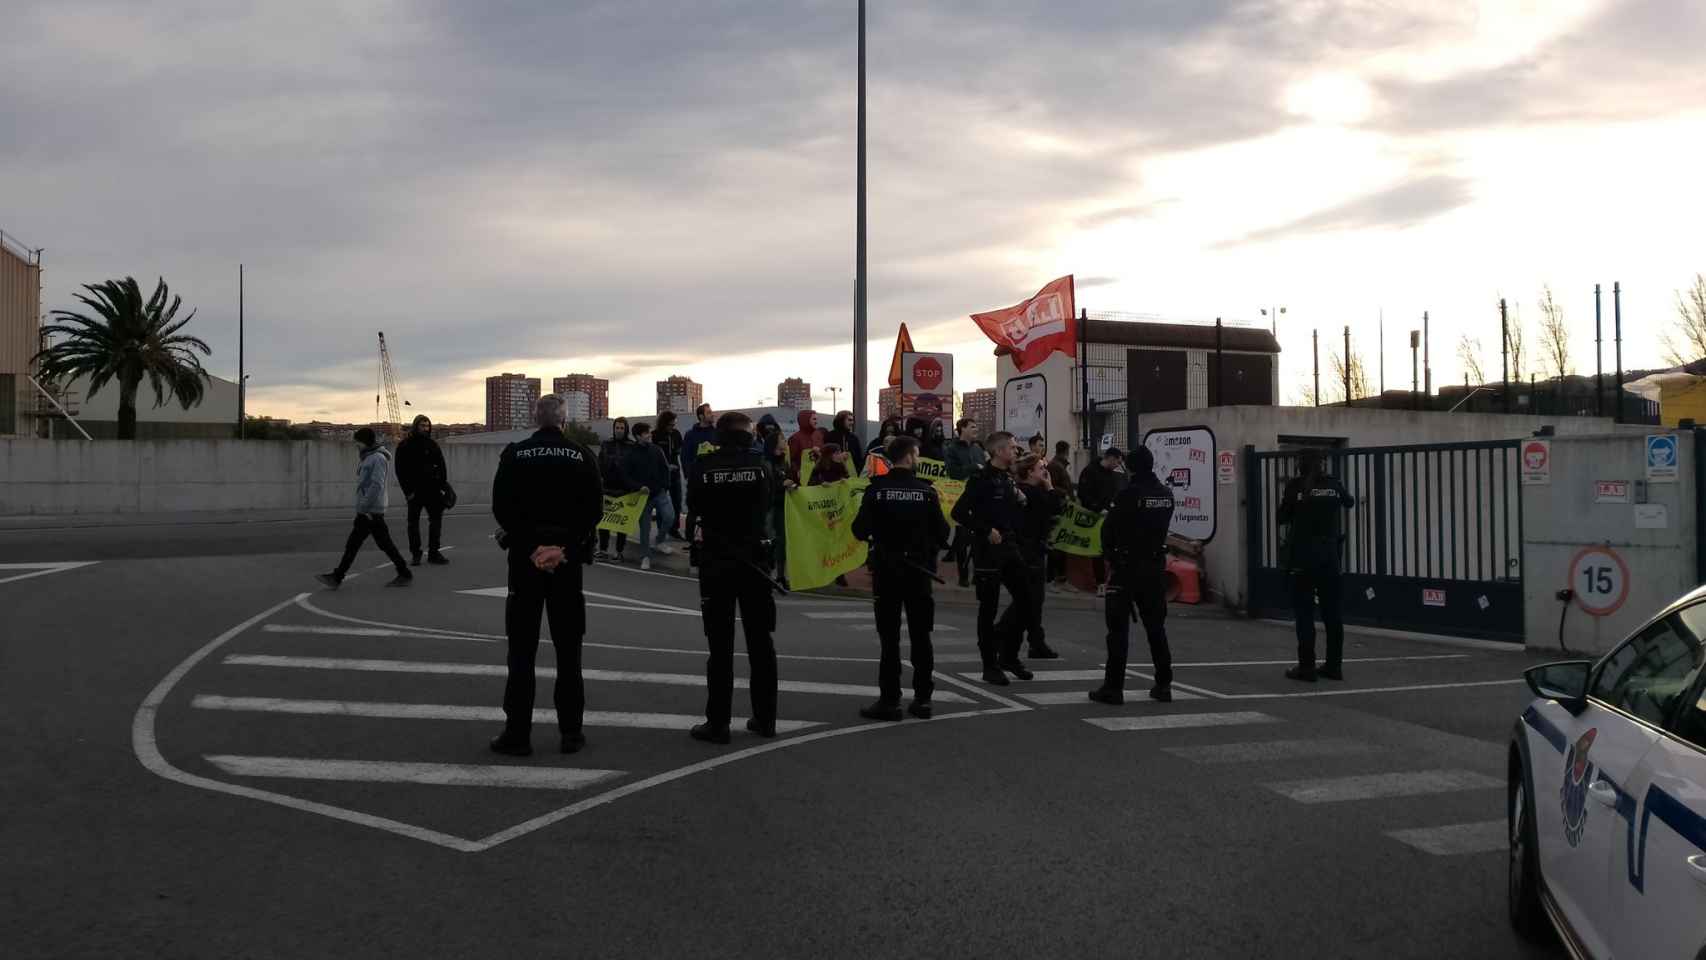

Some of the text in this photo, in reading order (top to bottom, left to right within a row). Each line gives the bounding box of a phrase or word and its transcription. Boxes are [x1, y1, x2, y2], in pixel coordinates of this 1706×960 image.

[915, 369, 941, 378] STOP
[516, 447, 584, 463] ERTZAINTZA
[918, 462, 948, 477] maz
[886, 491, 924, 502] ERTZAINTZA
[1583, 566, 1612, 594] 15
